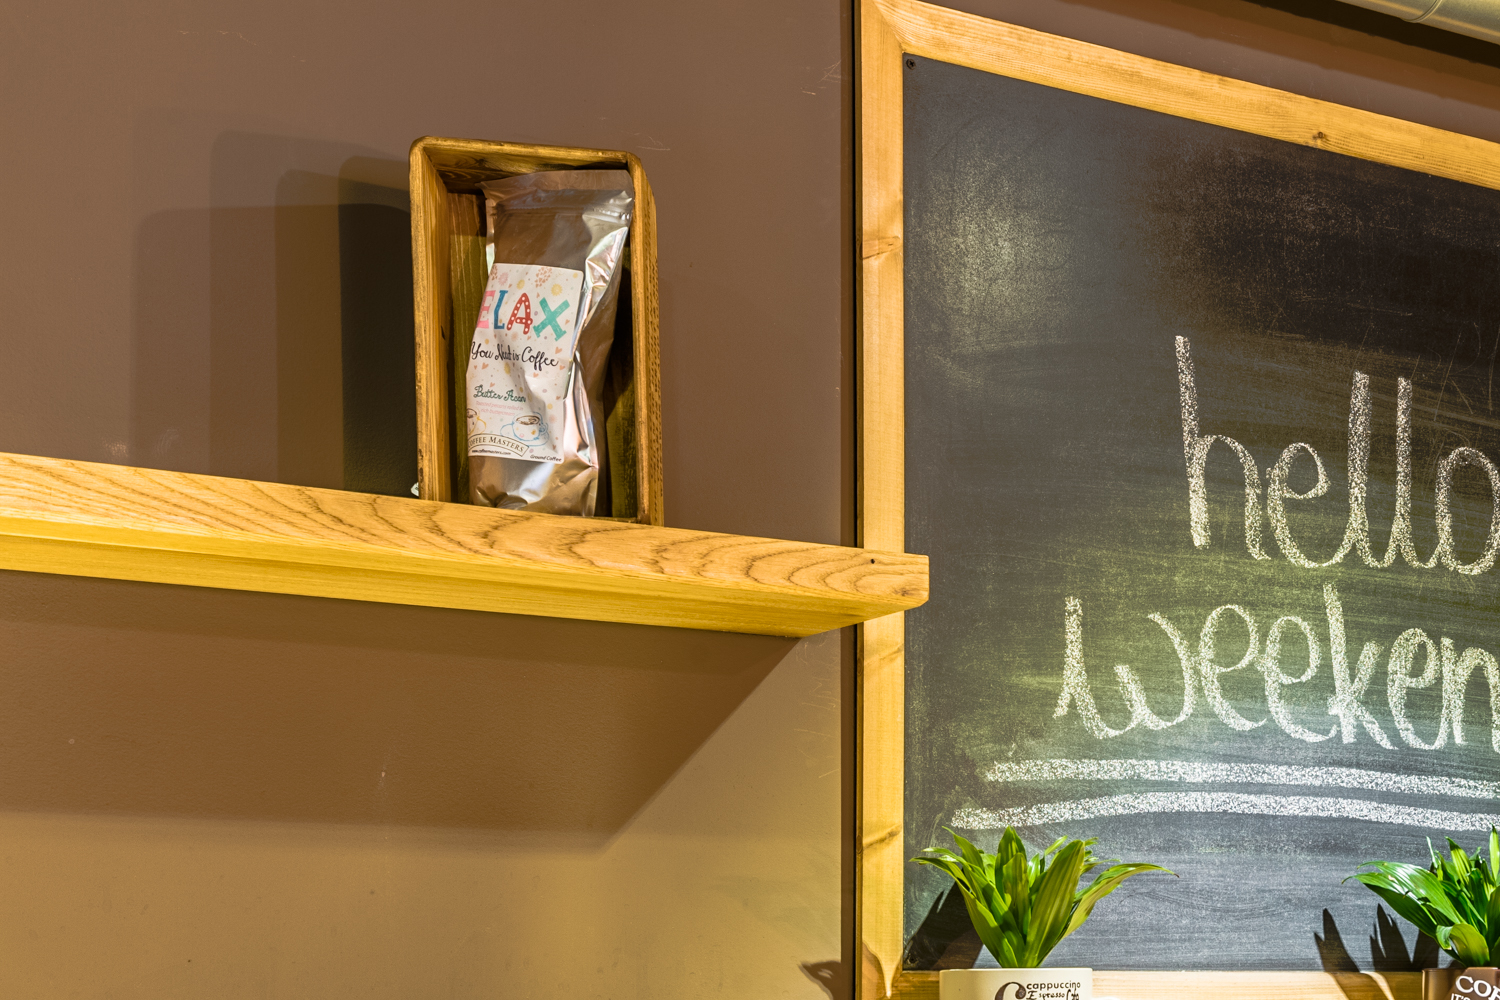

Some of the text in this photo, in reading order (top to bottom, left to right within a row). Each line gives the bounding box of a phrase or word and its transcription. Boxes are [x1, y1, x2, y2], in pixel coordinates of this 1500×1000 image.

[476, 290, 570, 342] ELAX
[471, 341, 494, 360] You
[522, 346, 559, 371] Coffee
[473, 384, 503, 400] Butter
[488, 436, 524, 453] MASTERS
[1026, 980, 1081, 992] cappuccino
